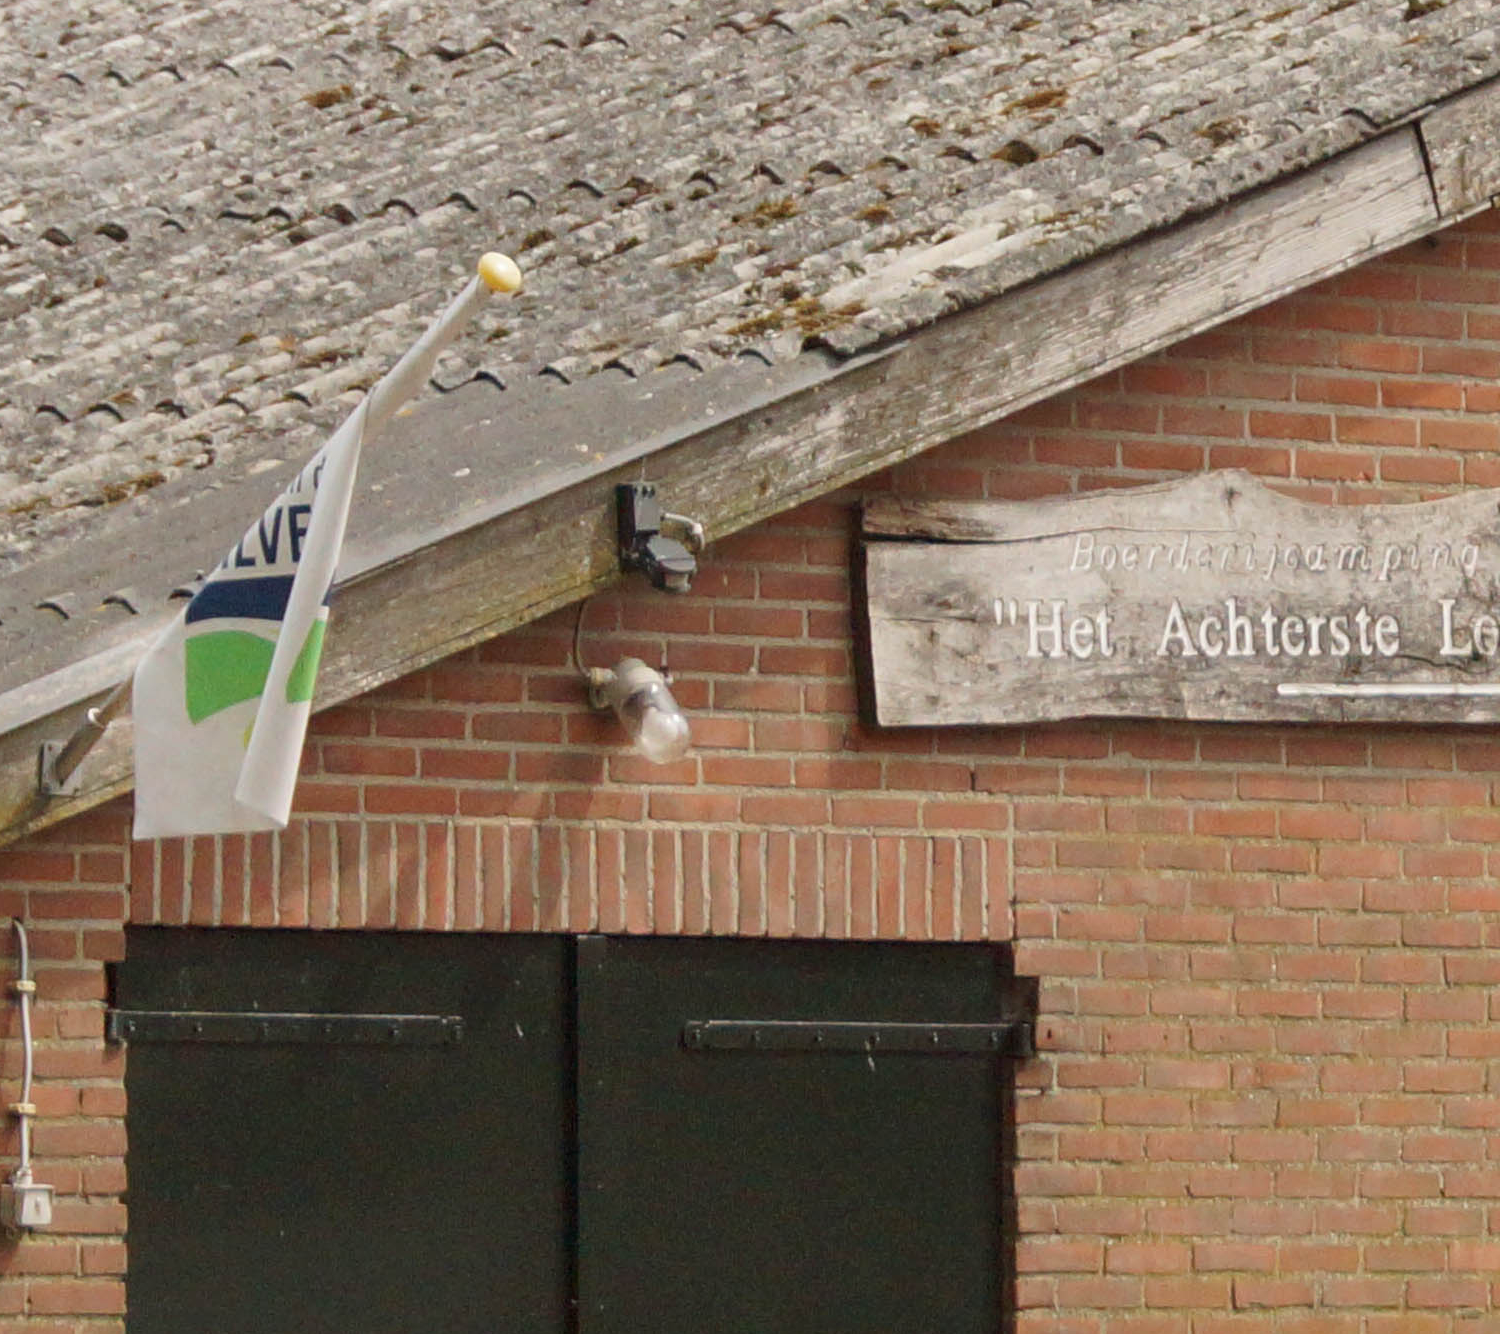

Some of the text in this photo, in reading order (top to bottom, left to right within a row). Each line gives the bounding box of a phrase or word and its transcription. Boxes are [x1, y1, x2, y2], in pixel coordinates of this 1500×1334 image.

[222, 504, 311, 568] LVE
[993, 597, 1115, 659] "Het
[1156, 596, 1400, 658] Achterste
